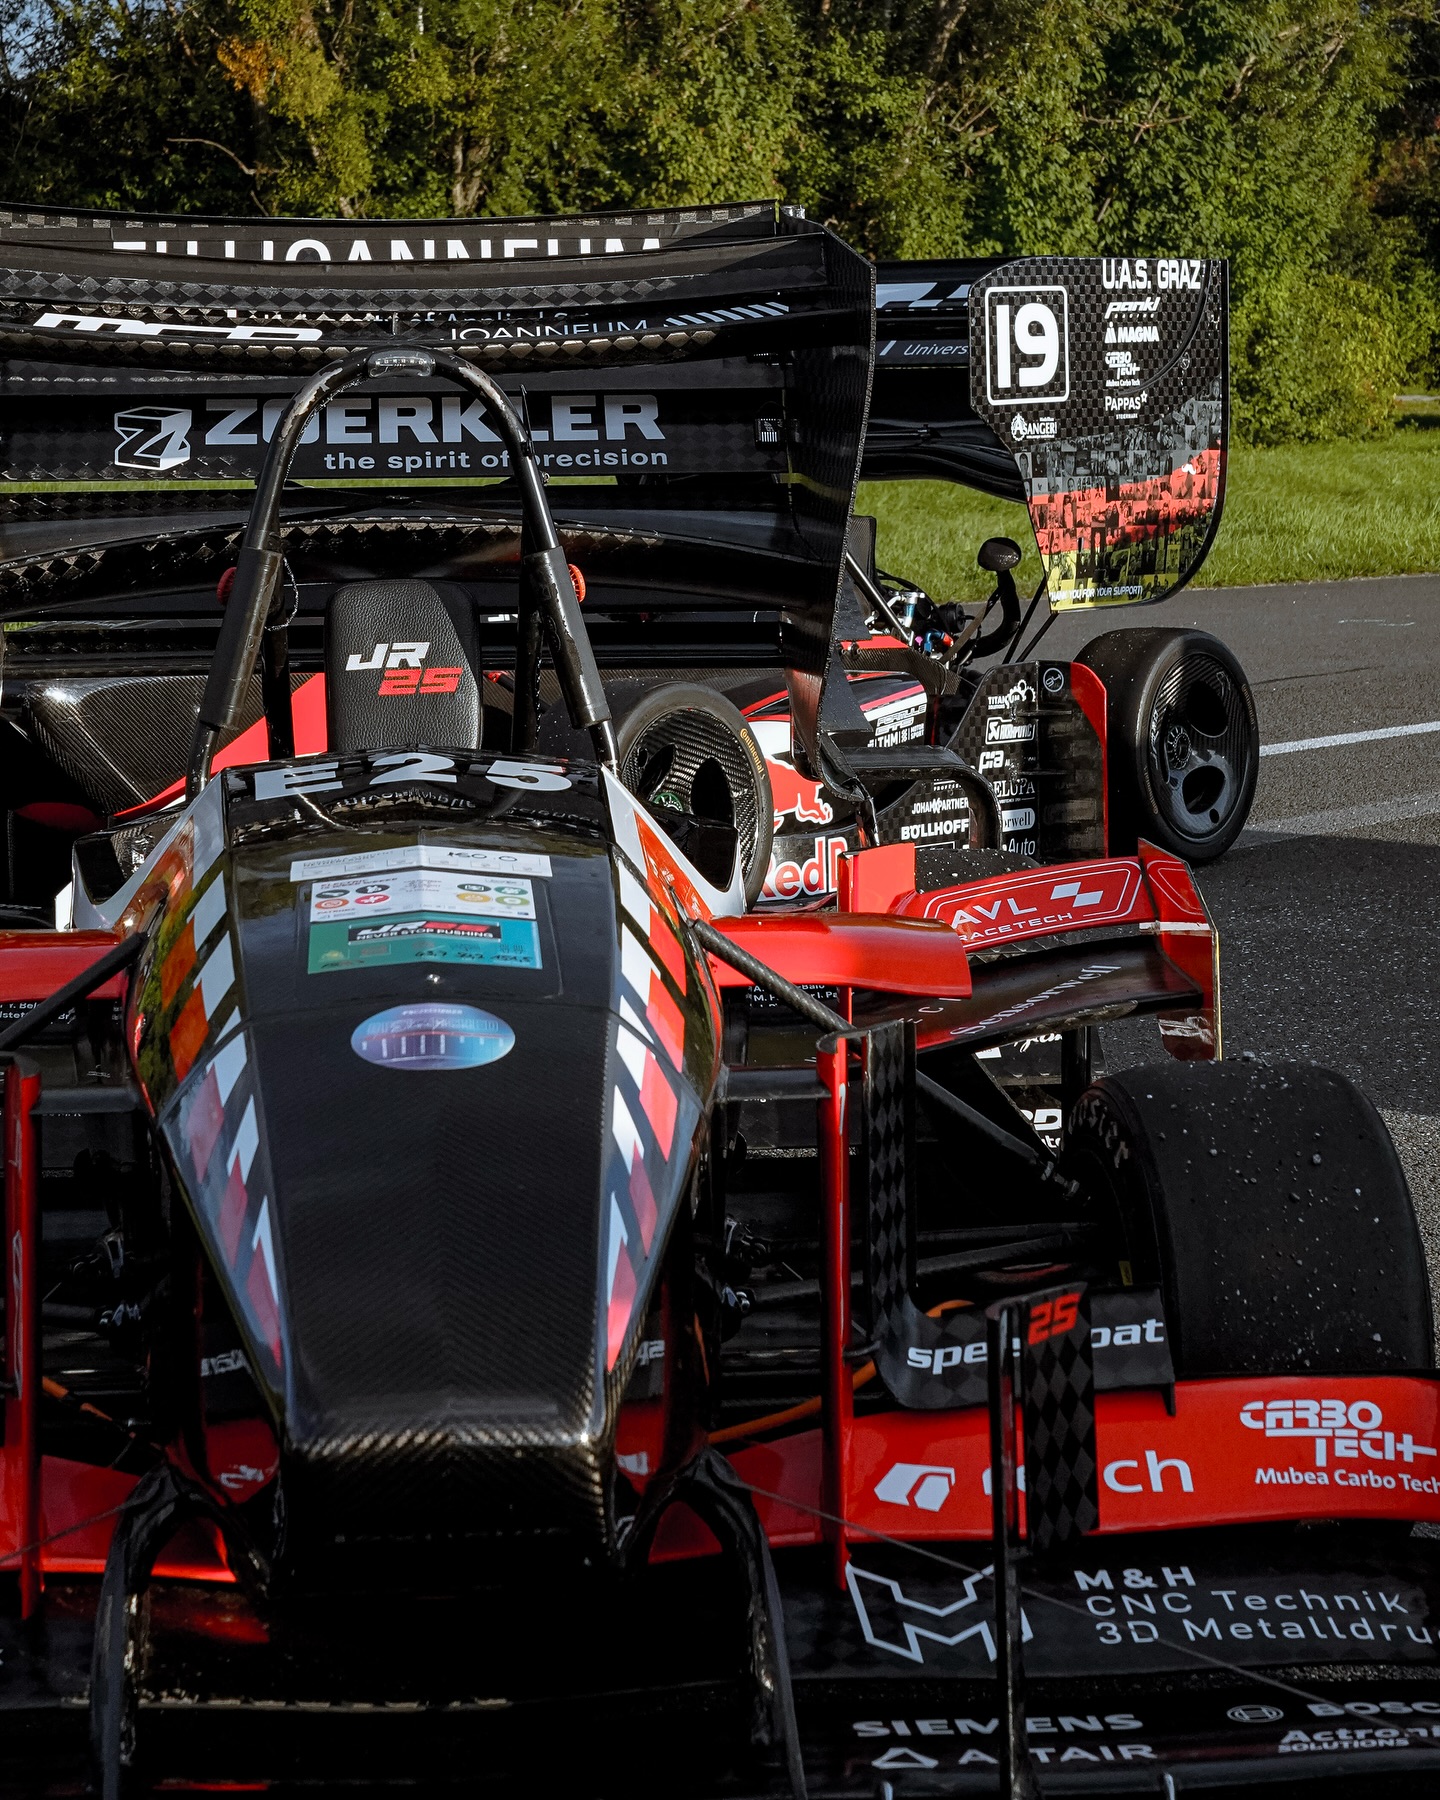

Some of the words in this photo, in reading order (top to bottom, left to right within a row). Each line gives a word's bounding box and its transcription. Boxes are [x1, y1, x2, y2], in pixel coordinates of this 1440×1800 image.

[1102, 259, 1152, 290] U.A.S.
[1157, 258, 1201, 289] GRAZ
[996, 302, 1060, 388] 19
[1117, 325, 1160, 343] MAGNA
[903, 343, 969, 356] Univers
[1105, 395, 1141, 411] PAPPAS
[324, 452, 375, 470] the
[387, 450, 470, 473] spirit
[481, 448, 510, 470] of
[536, 447, 669, 467] recision
[1096, 586, 1112, 597] YOUR
[345, 642, 430, 671] JR
[378, 667, 463, 696] 25
[740, 728, 765, 774] Continental
[952, 898, 1038, 929] AVL
[958, 912, 1074, 942] RACETECH
[401, 927, 434, 936] STOP
[437, 928, 494, 939] PUSHING
[1028, 1292, 1081, 1345] 25
[1239, 1399, 1383, 1431] CARBO
[1265, 1427, 1438, 1468] TECH
[1255, 1466, 1330, 1485] Mubea
[1334, 1468, 1396, 1489] Carbo
[1074, 1570, 1114, 1591] M
[1161, 1566, 1197, 1587] H
[1086, 1592, 1192, 1617] CNC
[1211, 1588, 1409, 1614] Technik
[1095, 1620, 1159, 1645] 3D
[1182, 1615, 1440, 1645] Metalldru
[1307, 1701, 1440, 1717] BOSC
[958, 1744, 1158, 1766] ATAIR
[1277, 1738, 1410, 1754] SOLUTIONS
